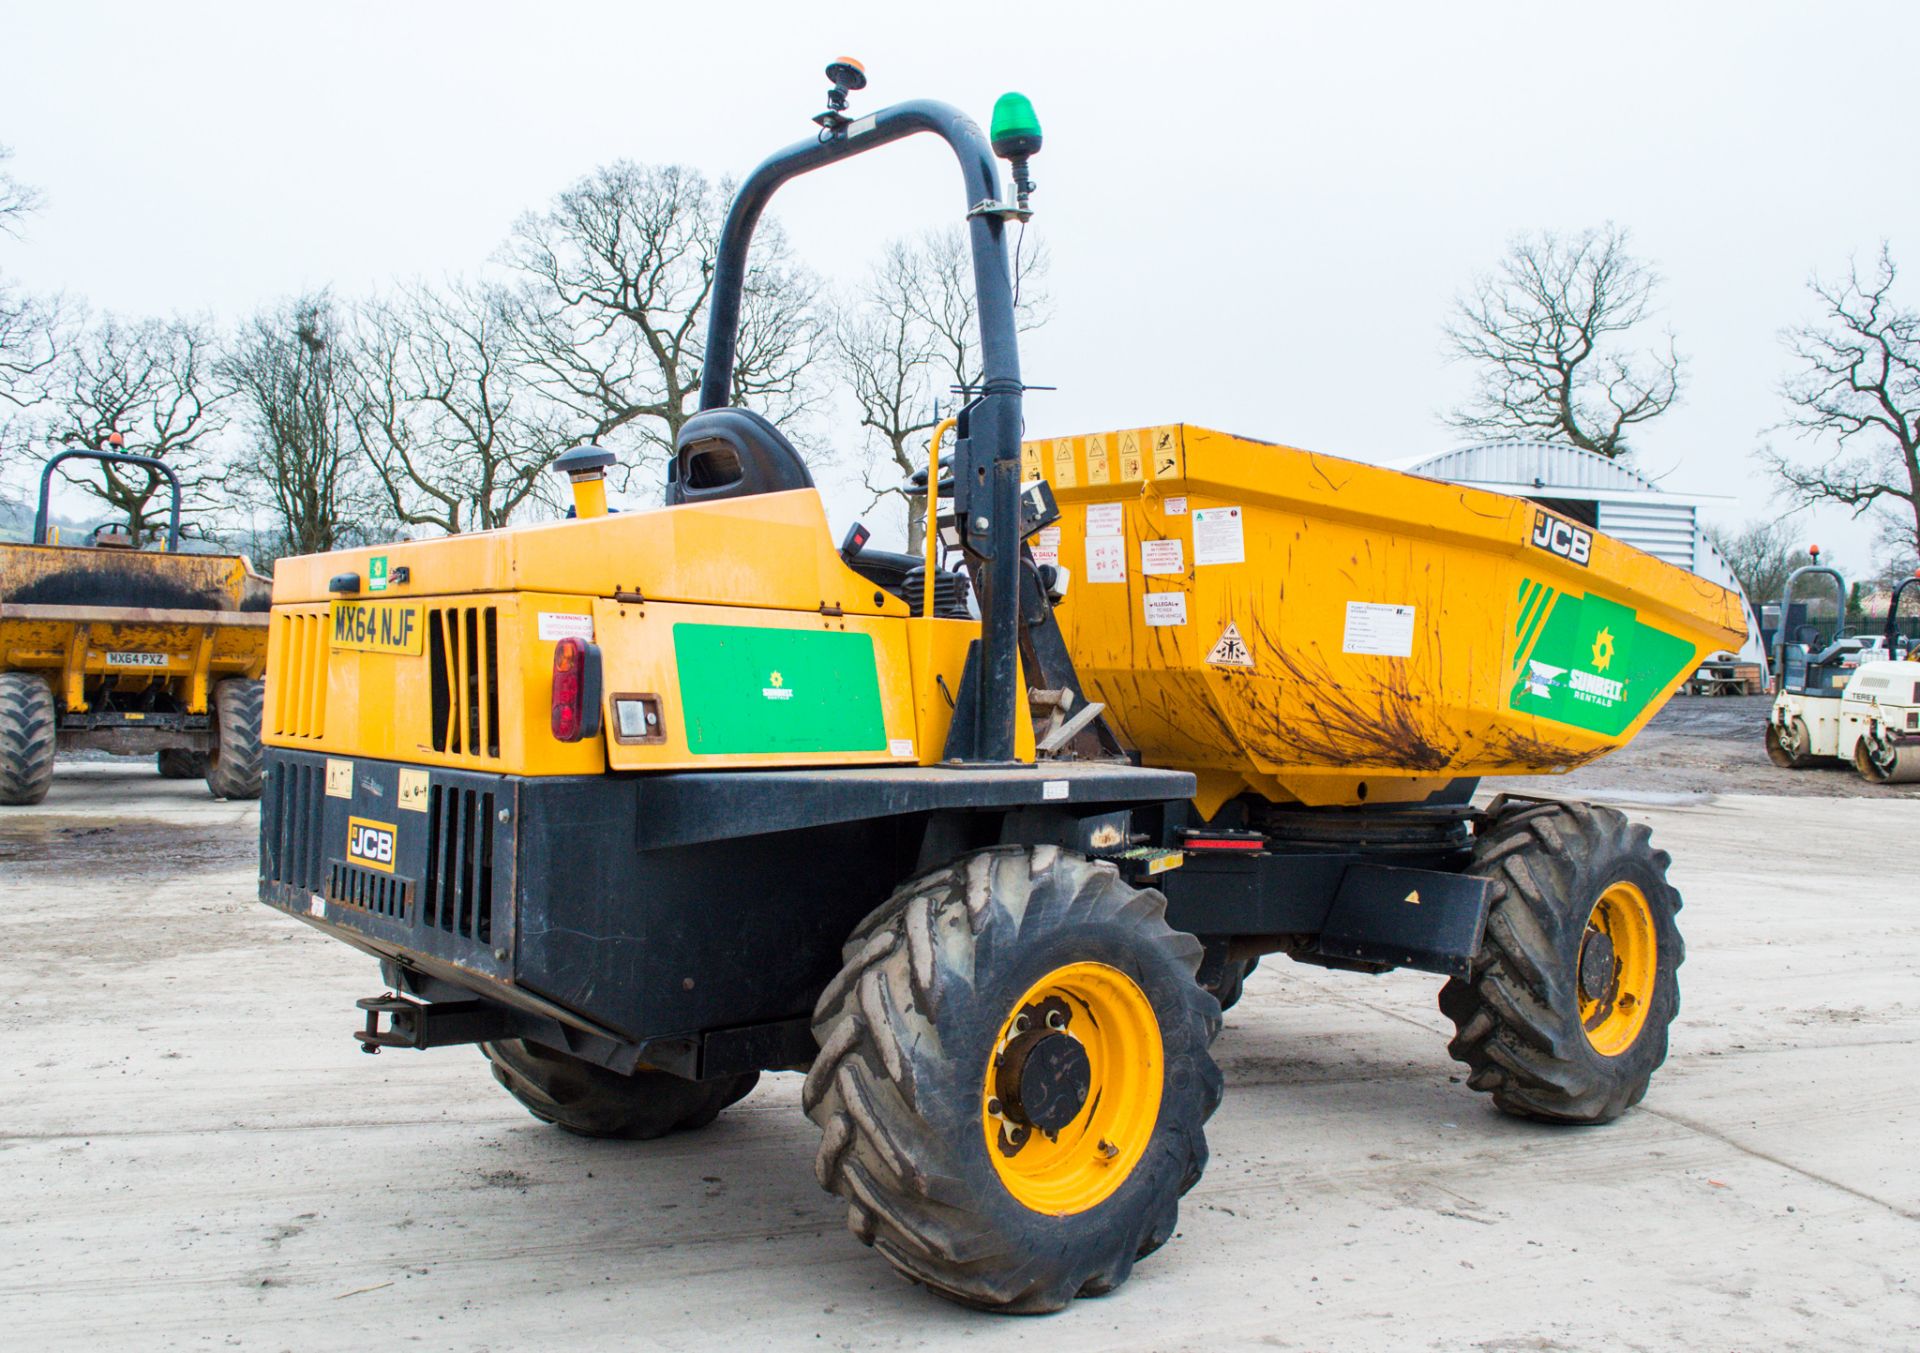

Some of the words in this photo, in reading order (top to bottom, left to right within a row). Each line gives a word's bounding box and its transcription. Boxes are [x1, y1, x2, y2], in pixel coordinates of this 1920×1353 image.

[1532, 516, 1591, 563] JCB
[335, 606, 376, 643] MX64
[381, 608, 415, 647] NJF
[141, 654, 164, 664] PXZ
[1568, 668, 1624, 702] SUNBELT
[1573, 690, 1613, 708] RENTALS
[351, 827, 393, 862] JCB
